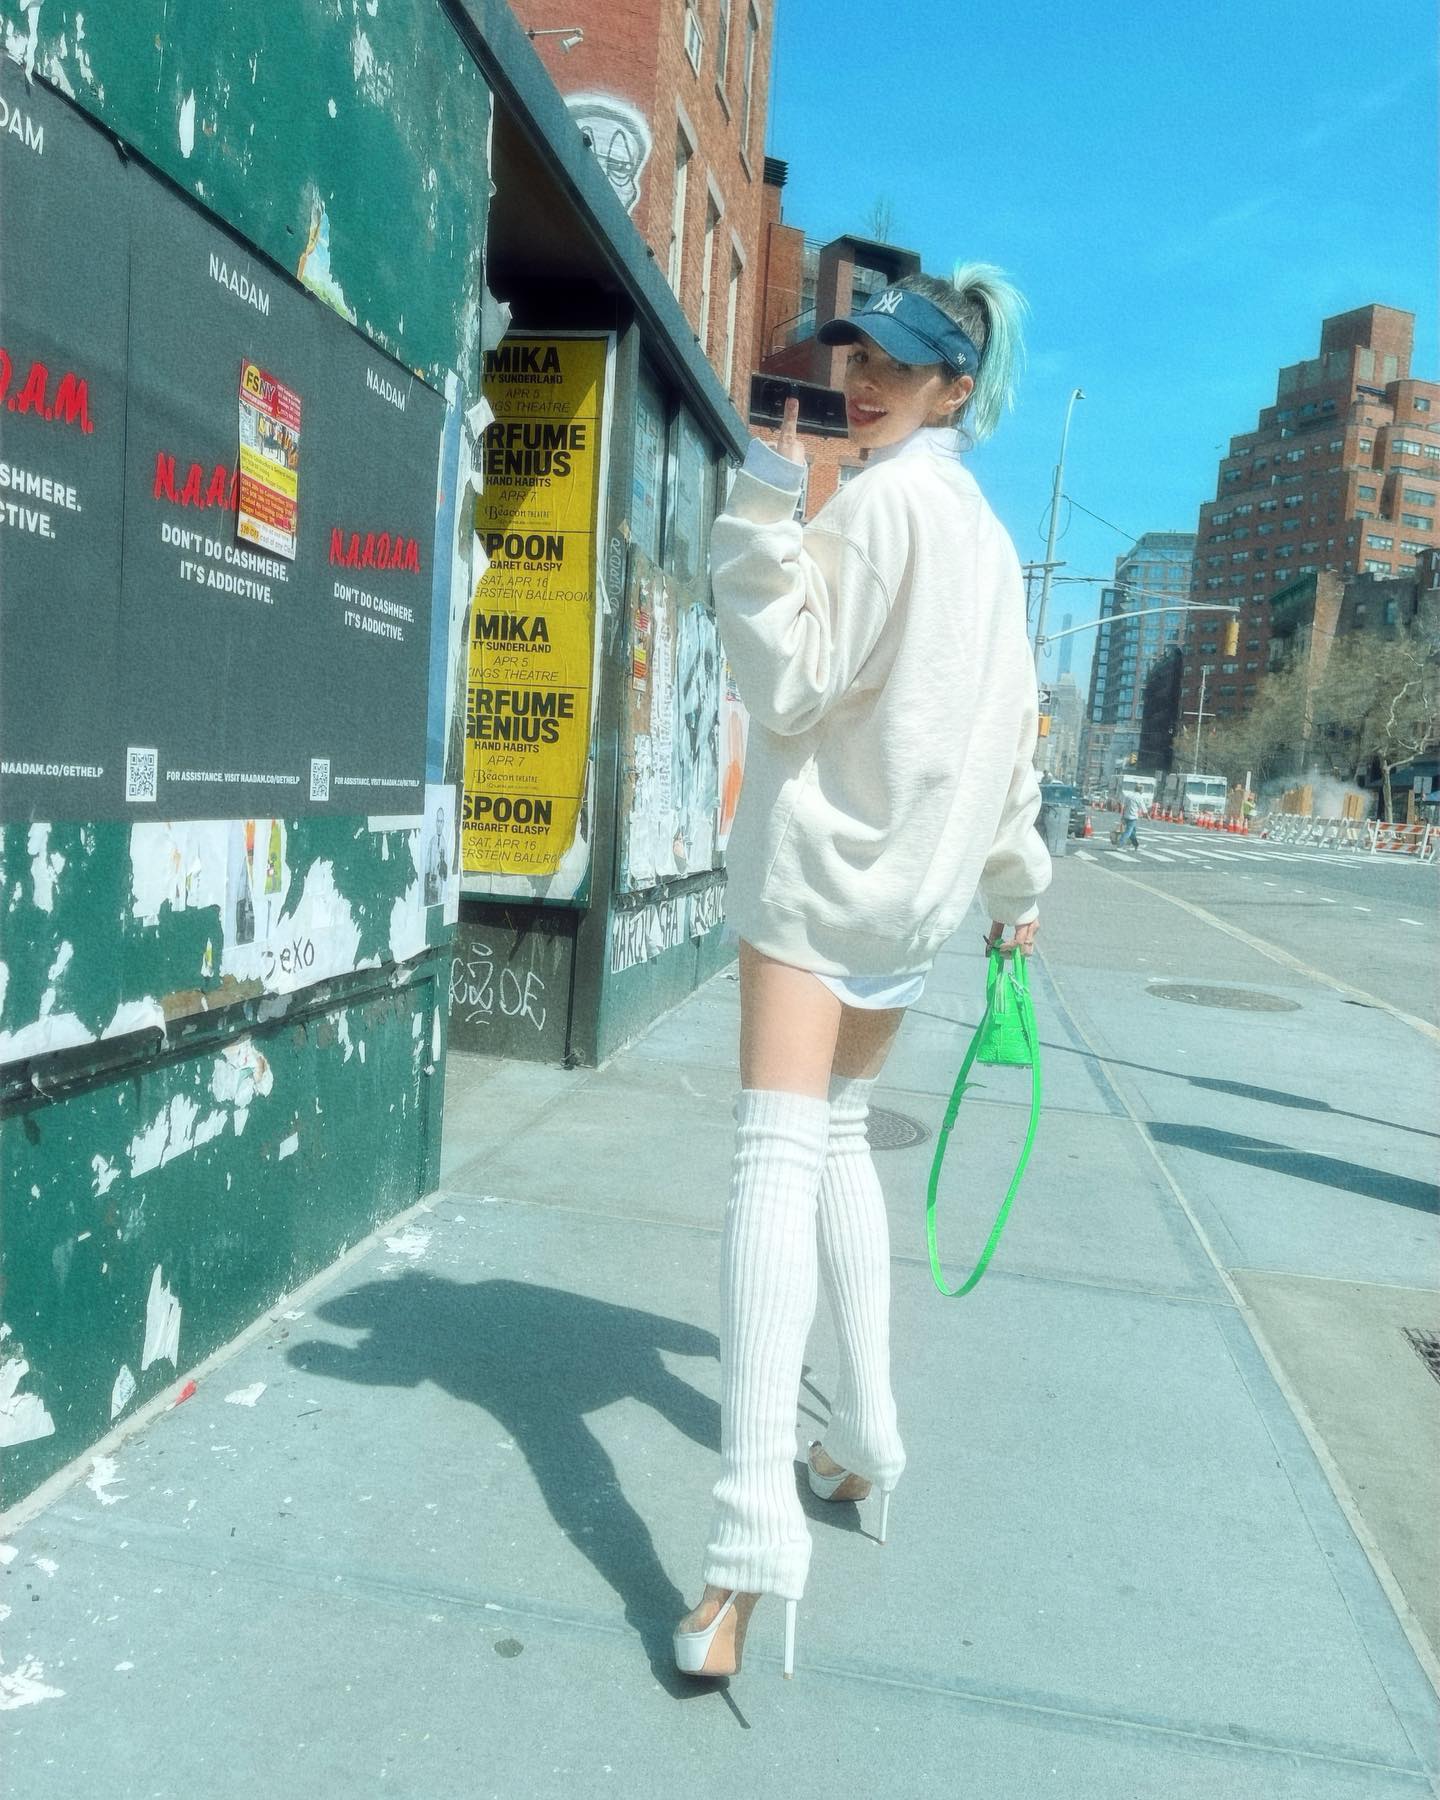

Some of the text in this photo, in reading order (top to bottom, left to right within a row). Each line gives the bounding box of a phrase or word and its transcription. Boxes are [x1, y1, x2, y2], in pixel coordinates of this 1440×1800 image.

[209, 252, 270, 316] NAADAM
[872, 290, 904, 314] NY
[486, 346, 561, 373] MIKA
[246, 370, 276, 401] FSNY
[498, 373, 564, 385] SUNDERLAND
[366, 367, 406, 413] NAADAM
[504, 387, 540, 399] APR 5
[517, 401, 570, 414] THEATRE
[484, 449, 571, 477] ENIUS
[486, 476, 552, 488] HAND HABITS
[499, 490, 538, 502] APR 7
[484, 504, 526, 520] Beacon
[161, 522, 203, 554] DON'T
[204, 537, 222, 561] DO
[224, 545, 289, 582] CASHMERE.
[523, 561, 563, 572] GLASPY
[180, 560, 274, 605] IT'S ADDICTIVE.
[506, 576, 532, 587] APR
[534, 577, 549, 588] 16
[333, 582, 415, 623] DON'T DO CASHMERE.
[525, 589, 593, 602] BALLROOM
[344, 610, 404, 641] IT'S ADDICTIVE.
[475, 613, 549, 642] MIKA
[472, 640, 552, 654] TY SUNDERLAND
[493, 655, 529, 668] APR 5
[504, 668, 559, 682] THEATRE
[474, 740, 540, 753] HAND HABITS
[487, 754, 526, 768] APR 7
[0, 761, 104, 778] NAADAM.CO/GETHELP
[166, 770, 181, 781] FOR
[223, 772, 240, 783] VISIT
[473, 768, 514, 784] Beacon
[511, 823, 551, 836] GLASPY
[494, 838, 521, 850] APR
[524, 840, 537, 851] 16
